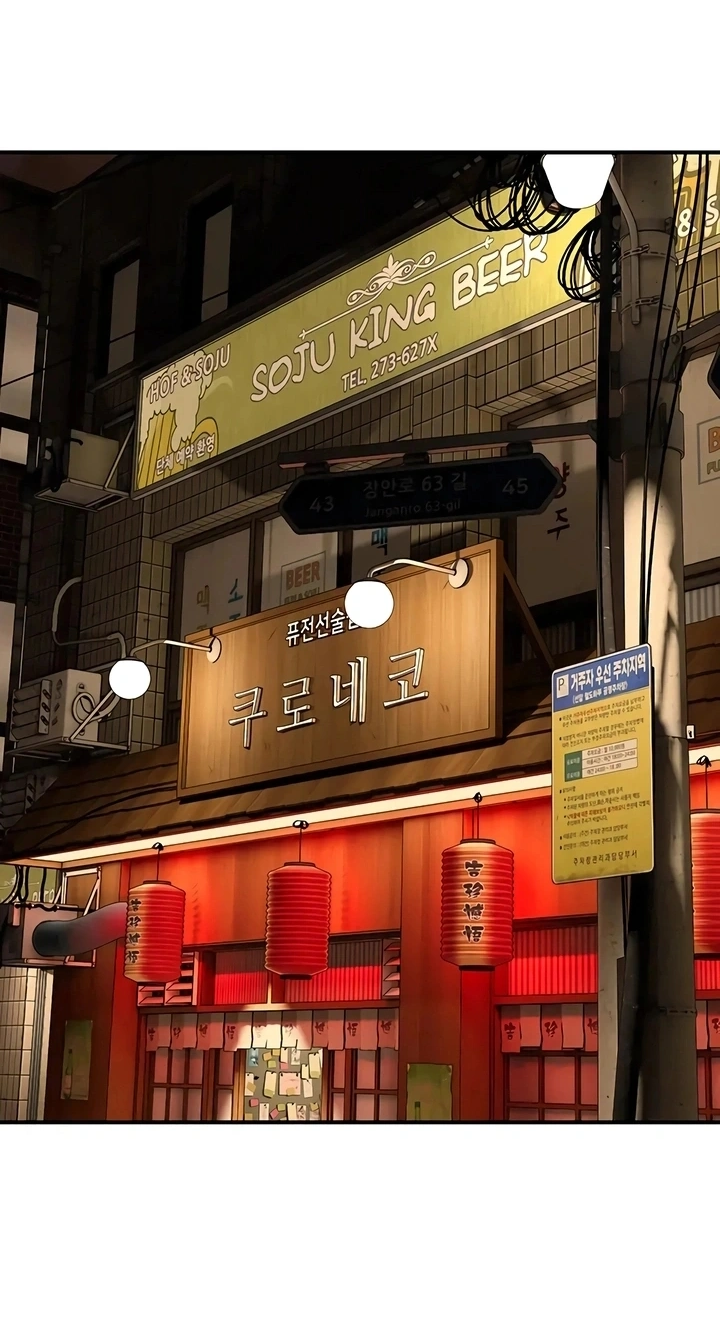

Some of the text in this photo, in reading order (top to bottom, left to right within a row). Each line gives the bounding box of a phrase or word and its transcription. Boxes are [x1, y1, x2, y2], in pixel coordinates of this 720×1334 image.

[250, 231, 548, 402] SOJU KING BEER
[150, 371, 178, 404] HOF
[195, 343, 231, 381] SOJU
[371, 332, 438, 381] 273-627X
[156, 453, 174, 476] 단체
[196, 432, 215, 458] 환영
[309, 496, 335, 512] 43
[363, 470, 467, 499] 장안로 63 길
[502, 478, 529, 495] 45
[286, 561, 320, 591] BEER
[571, 652, 646, 692] 거주자 우선 주차지역
[228, 647, 429, 749] 쿠로네코
